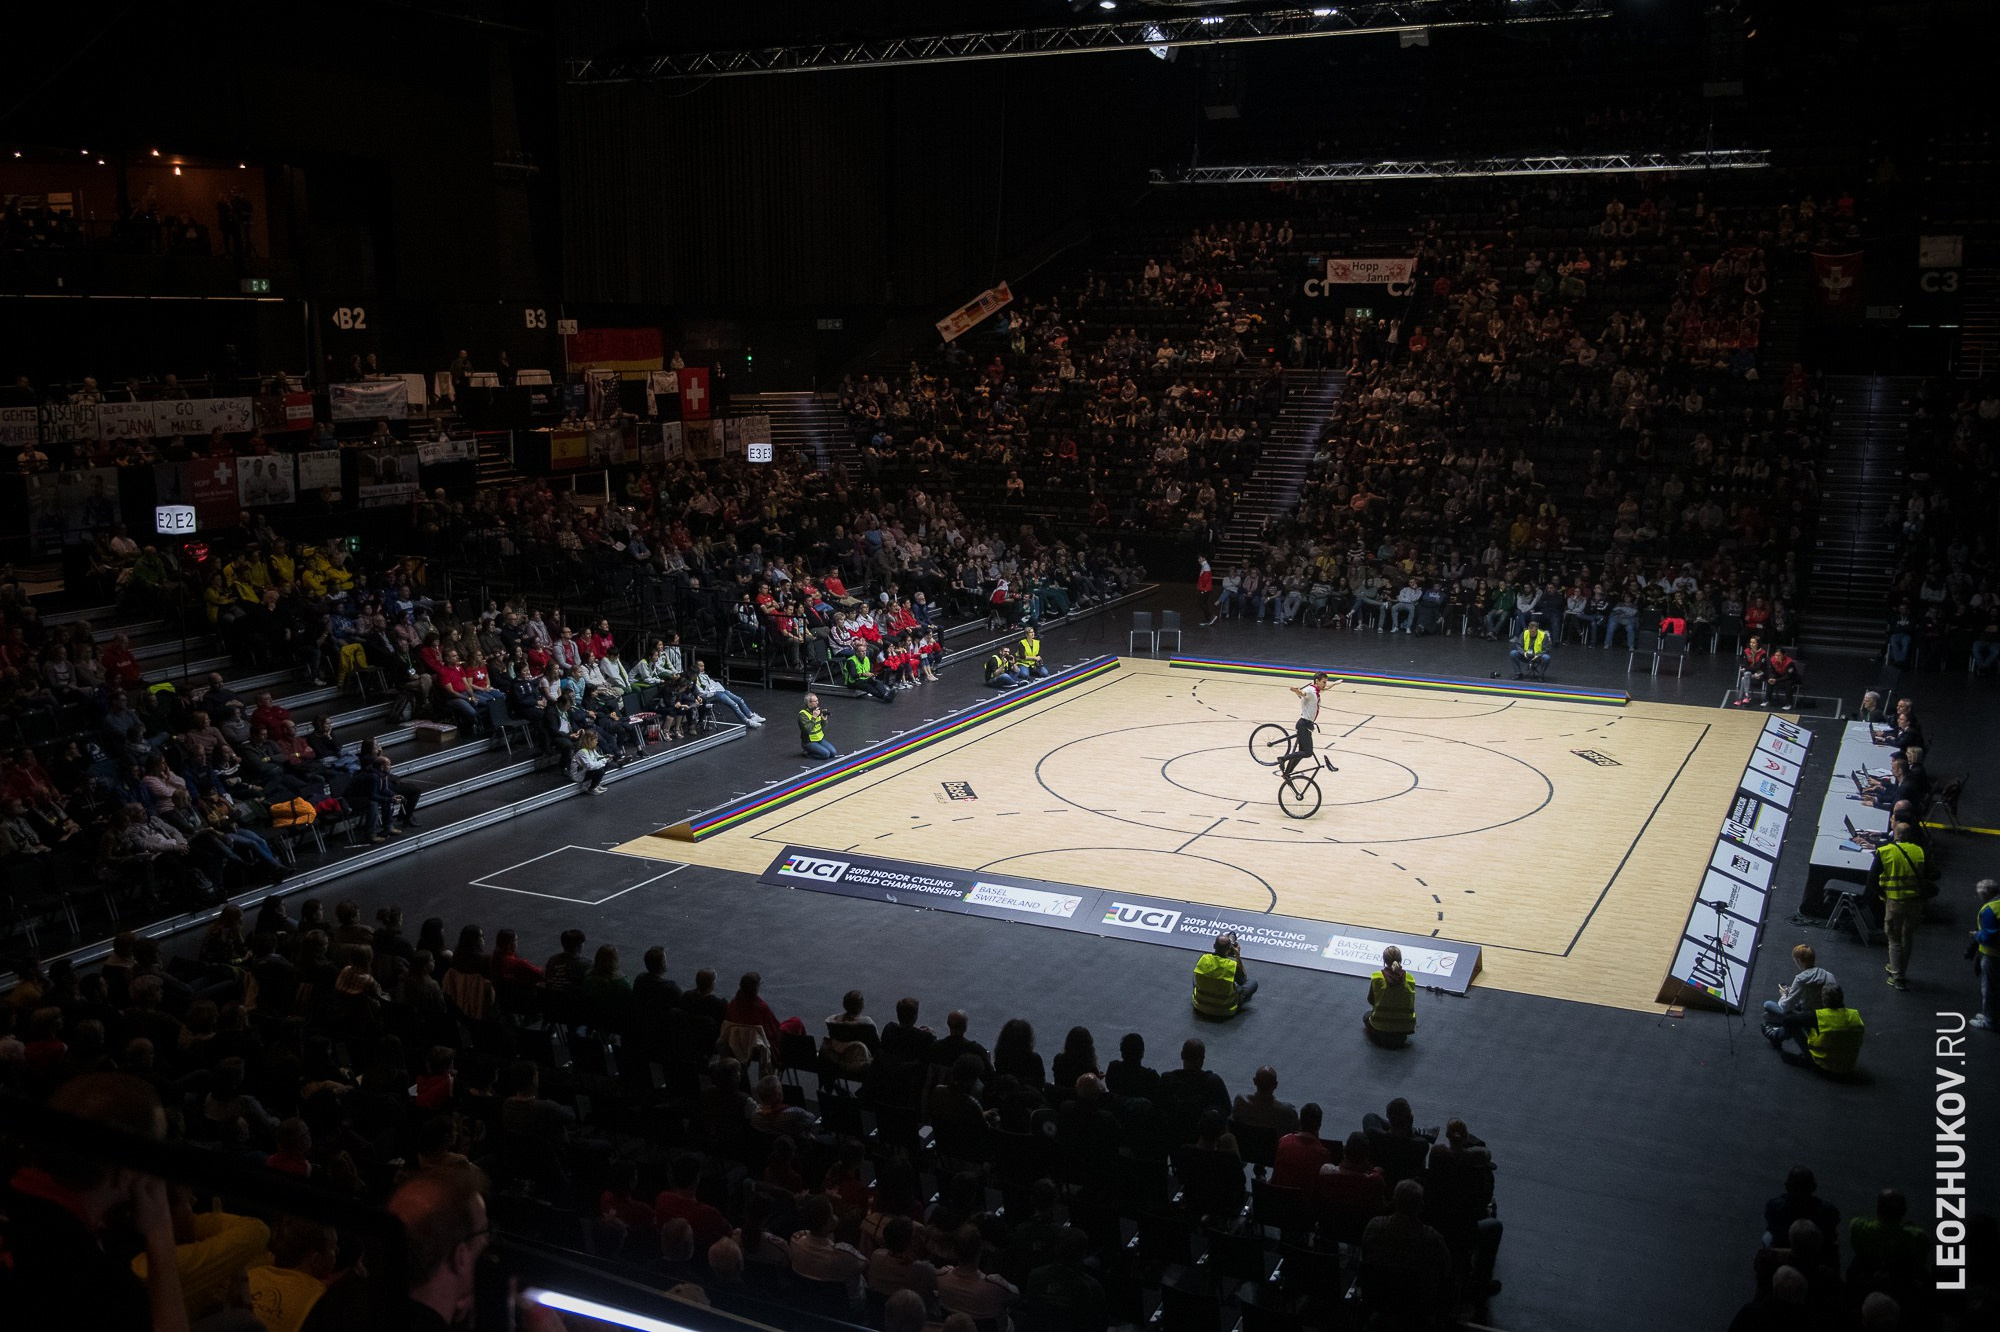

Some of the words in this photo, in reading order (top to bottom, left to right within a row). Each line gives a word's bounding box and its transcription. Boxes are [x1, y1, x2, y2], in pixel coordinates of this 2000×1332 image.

[1352, 261, 1379, 273] Hopp
[1303, 278, 1330, 298] C1
[1920, 271, 1959, 293] C3
[339, 307, 367, 330] B2
[525, 308, 547, 329] B3
[2, 409, 36, 422] GEHTS
[176, 402, 194, 415] GO
[118, 418, 155, 436] JANA
[750, 448, 762, 459] E3
[158, 512, 173, 529] E2
[176, 512, 194, 529] E2
[1726, 821, 1748, 839] UCI
[793, 859, 843, 879] UCI
[848, 867, 870, 876] 2019
[870, 870, 911, 882] INDOOR
[911, 876, 954, 888] CYCLING
[845, 873, 880, 885] WORLD
[881, 879, 963, 898] CHAMPIONSHIPS
[978, 886, 1007, 896] BASEL
[974, 893, 1041, 909] SWITZERLAND
[1117, 906, 1174, 929] UCI
[1179, 924, 1221, 937] WORLD
[1222, 931, 1319, 953] CAMPIONSHIPS
[1183, 916, 1207, 927] 2019
[1208, 920, 1255, 934] INDOOR
[1256, 927, 1307, 942] CYCLING
[1337, 939, 1371, 952] BASEL
[1333, 947, 1412, 967] SWITZERD
[1691, 951, 1730, 989] UCI
